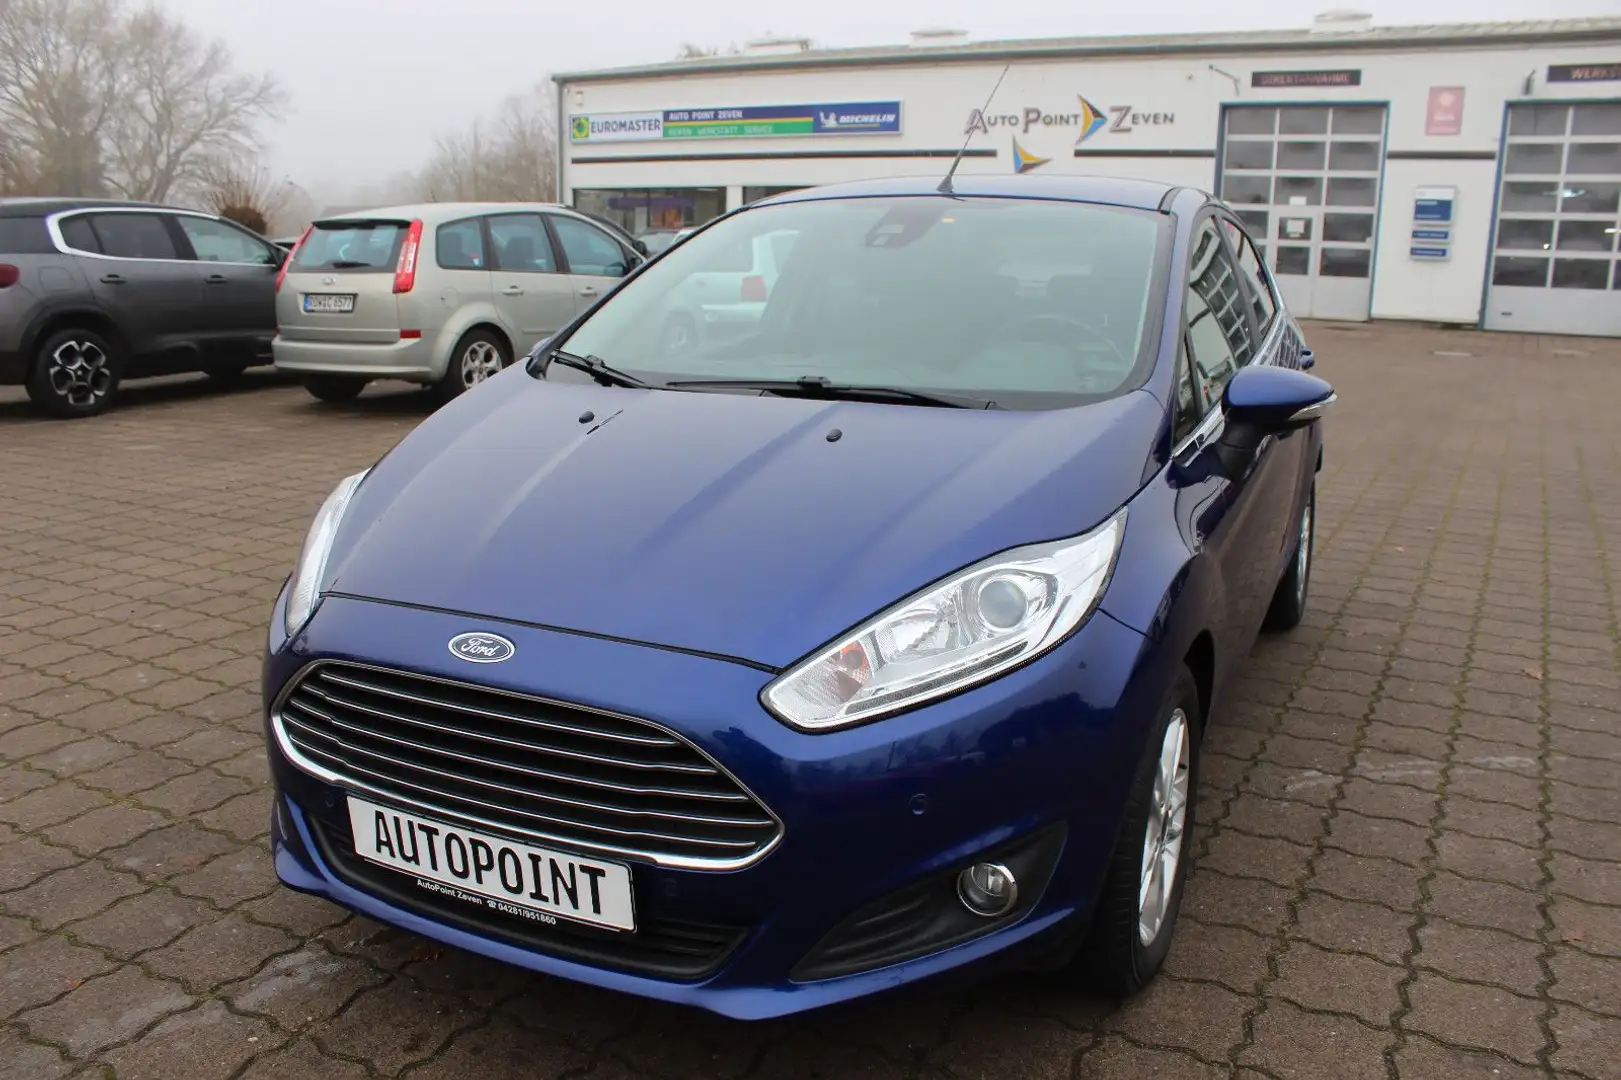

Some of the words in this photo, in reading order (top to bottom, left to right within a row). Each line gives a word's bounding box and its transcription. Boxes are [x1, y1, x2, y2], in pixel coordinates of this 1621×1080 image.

[668, 111, 689, 121] AUTO
[692, 110, 714, 120] POINT
[718, 109, 743, 119] ZEVEN
[839, 113, 896, 124] MICHELIN
[590, 118, 661, 134] EUROMASTER
[461, 637, 500, 657] Ford
[374, 809, 606, 915] AUTOPOINT
[416, 878, 456, 897] AutoPoint
[456, 890, 483, 905] Zeven
